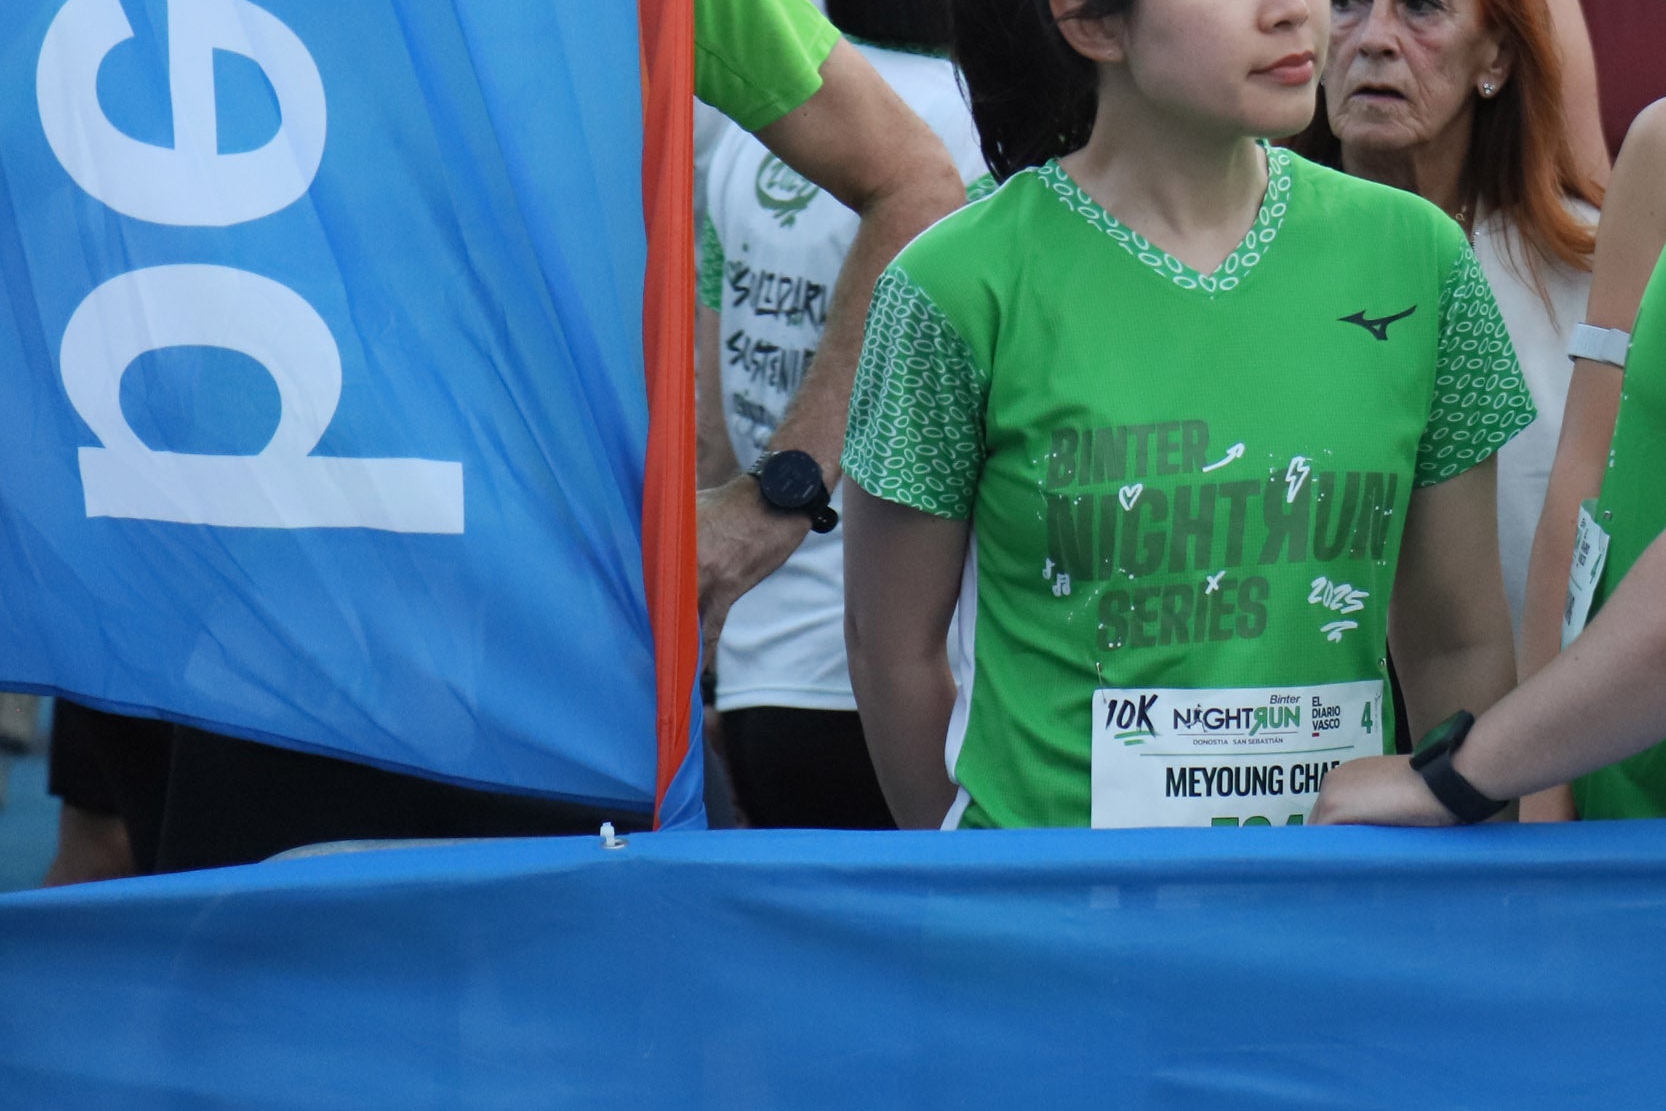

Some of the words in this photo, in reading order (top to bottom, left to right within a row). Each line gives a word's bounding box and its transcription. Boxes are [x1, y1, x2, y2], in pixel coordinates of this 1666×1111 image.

[1046, 420, 1209, 489] BINTER
[1308, 576, 1370, 614] 2025
[1098, 576, 1270, 651] SERIES
[1105, 694, 1160, 737] 10K
[1269, 694, 1301, 705] Binter
[1311, 697, 1323, 707] EL
[1311, 706, 1341, 719] DIARIO
[1311, 718, 1341, 731] VASCO
[1361, 701, 1373, 734] 4
[1165, 765, 1284, 798] MEYOUNG
[1289, 761, 1341, 794] CHA
